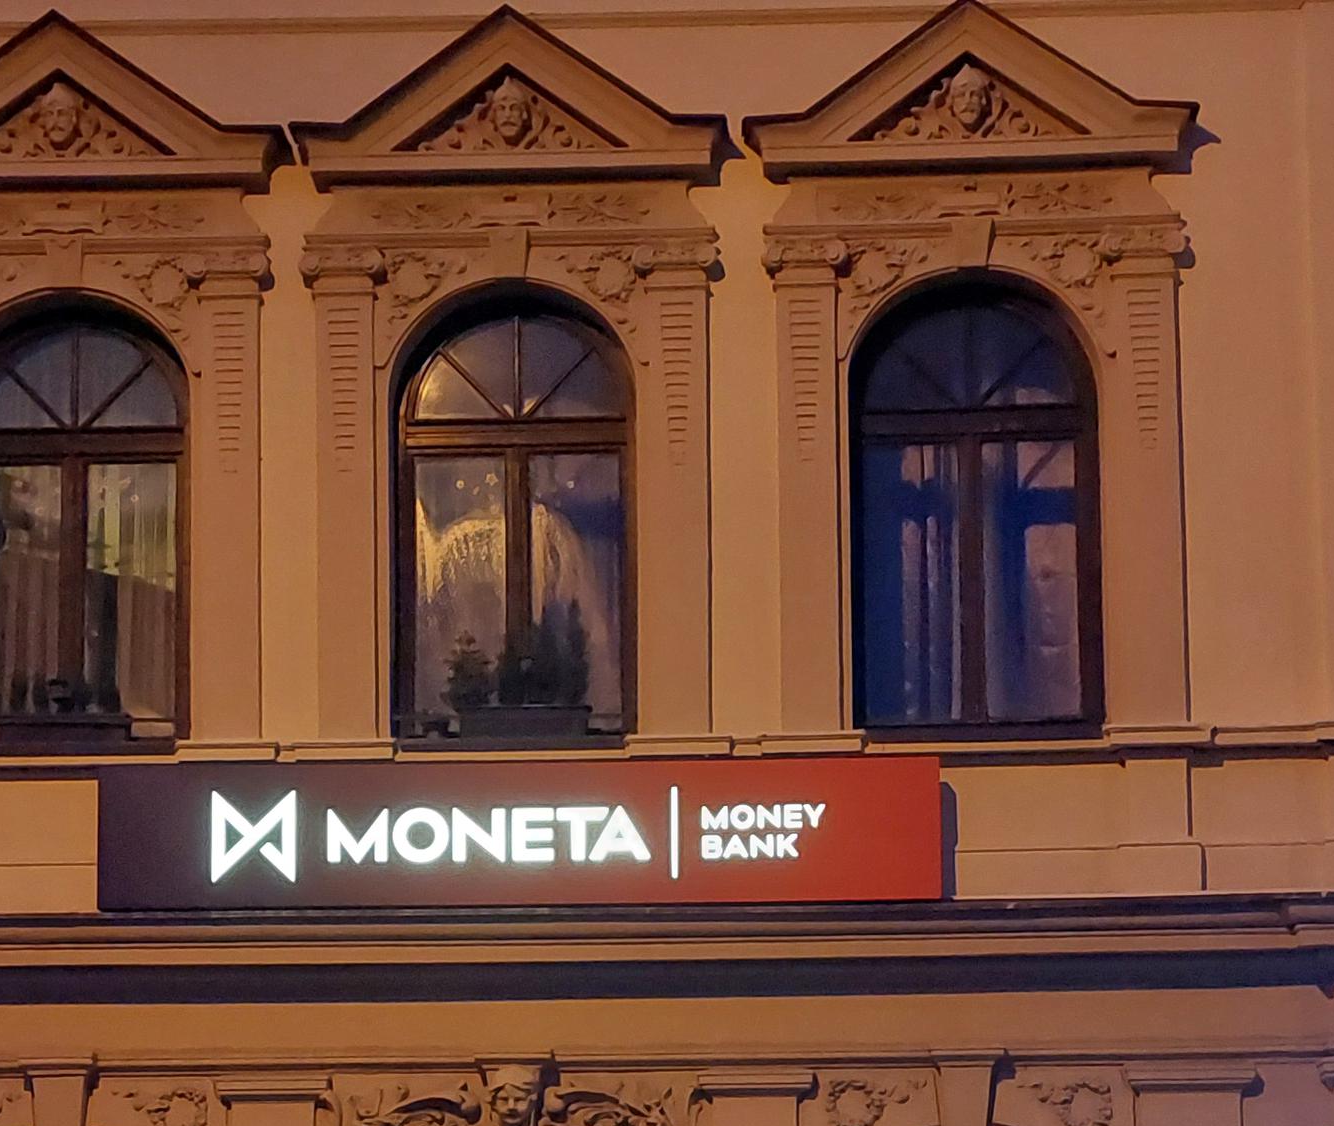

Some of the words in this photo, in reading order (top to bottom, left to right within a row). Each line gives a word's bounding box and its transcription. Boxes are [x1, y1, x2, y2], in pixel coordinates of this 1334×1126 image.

[700, 803, 827, 830] MONEY
[326, 804, 652, 864] MONETA
[700, 833, 799, 860] BANK
